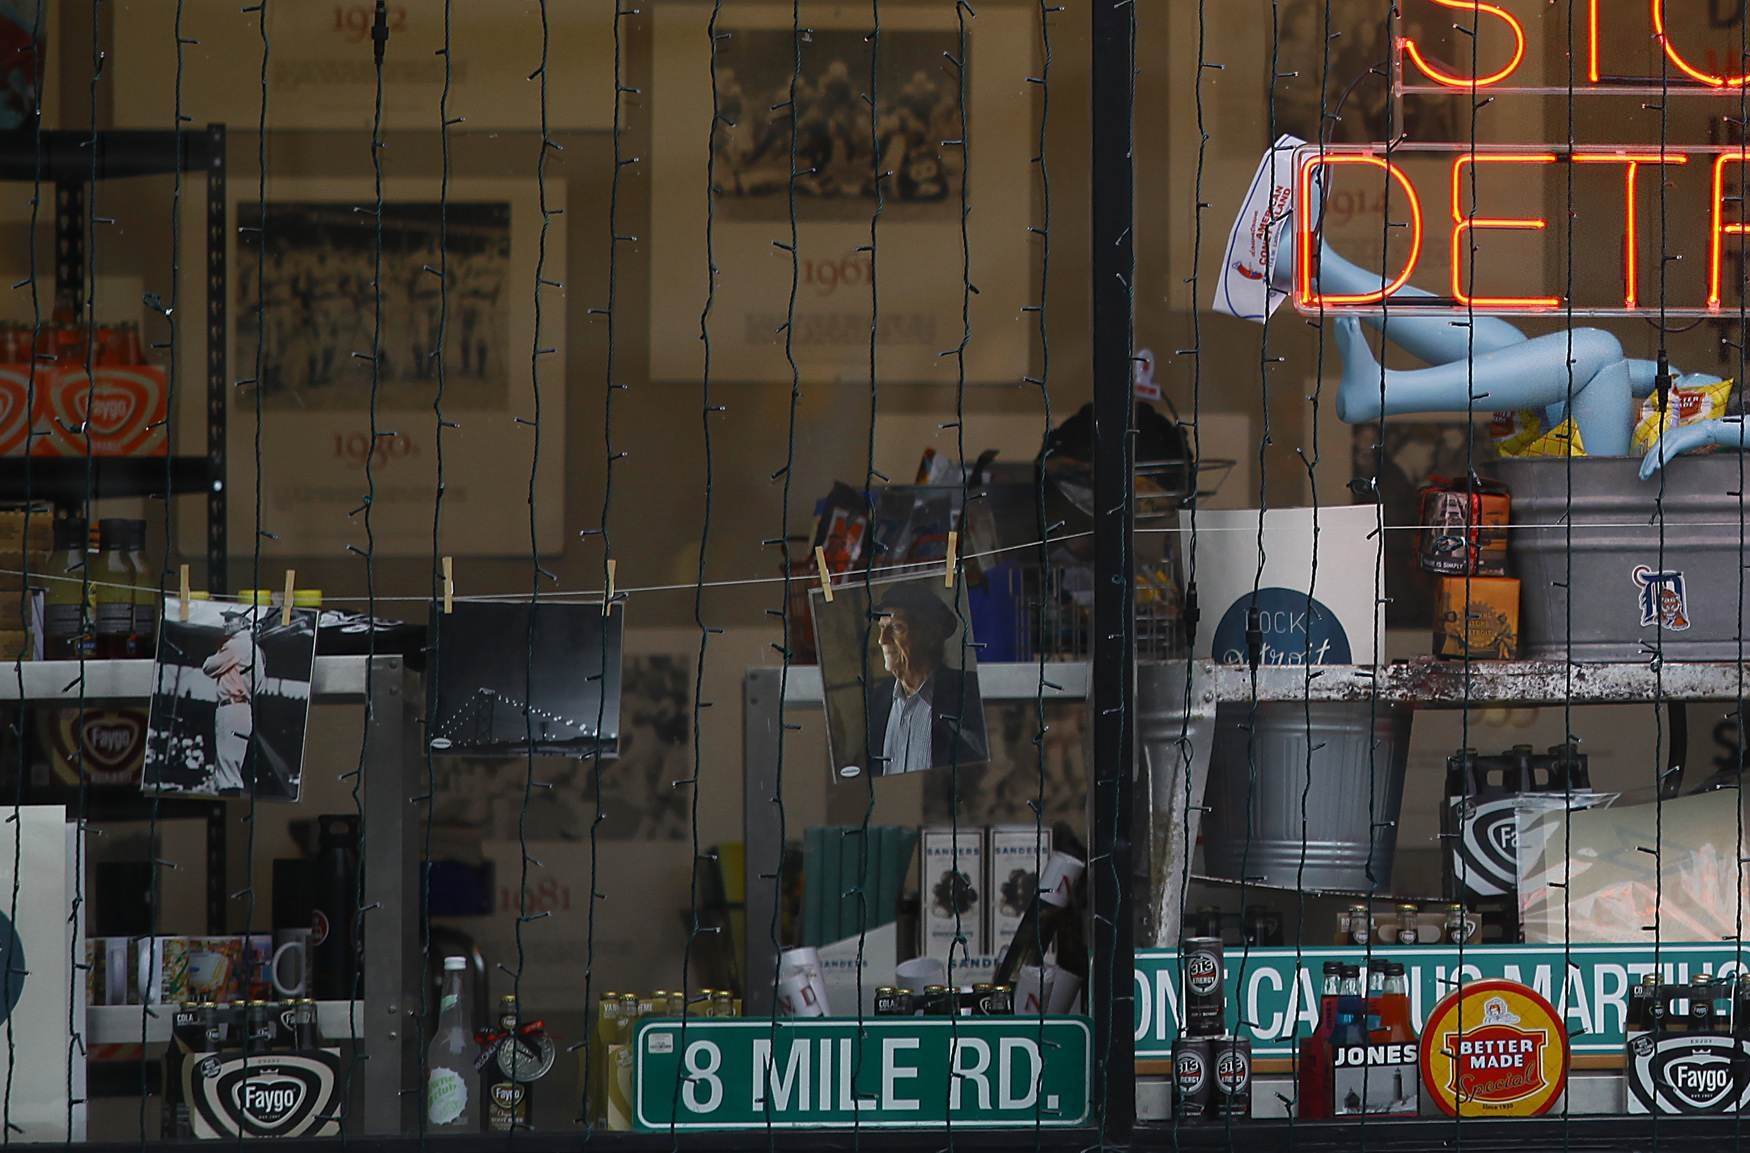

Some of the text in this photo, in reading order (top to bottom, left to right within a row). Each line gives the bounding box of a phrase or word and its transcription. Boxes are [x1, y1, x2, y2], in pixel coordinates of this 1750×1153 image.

[333, 5, 407, 42] 192
[1245, 611, 1307, 634] OCK
[994, 848, 1046, 856] SANDES
[1190, 959, 1214, 975] 313
[1335, 1044, 1418, 1066] JONES
[1459, 1039, 1533, 1055] BETTER
[1470, 1055, 1524, 1068] MADE
[681, 1038, 1060, 1114] 8 MILE RD.
[1457, 1063, 1537, 1104] Special
[1677, 1066, 1727, 1092] Faygo
[245, 1086, 294, 1113] Faygo
